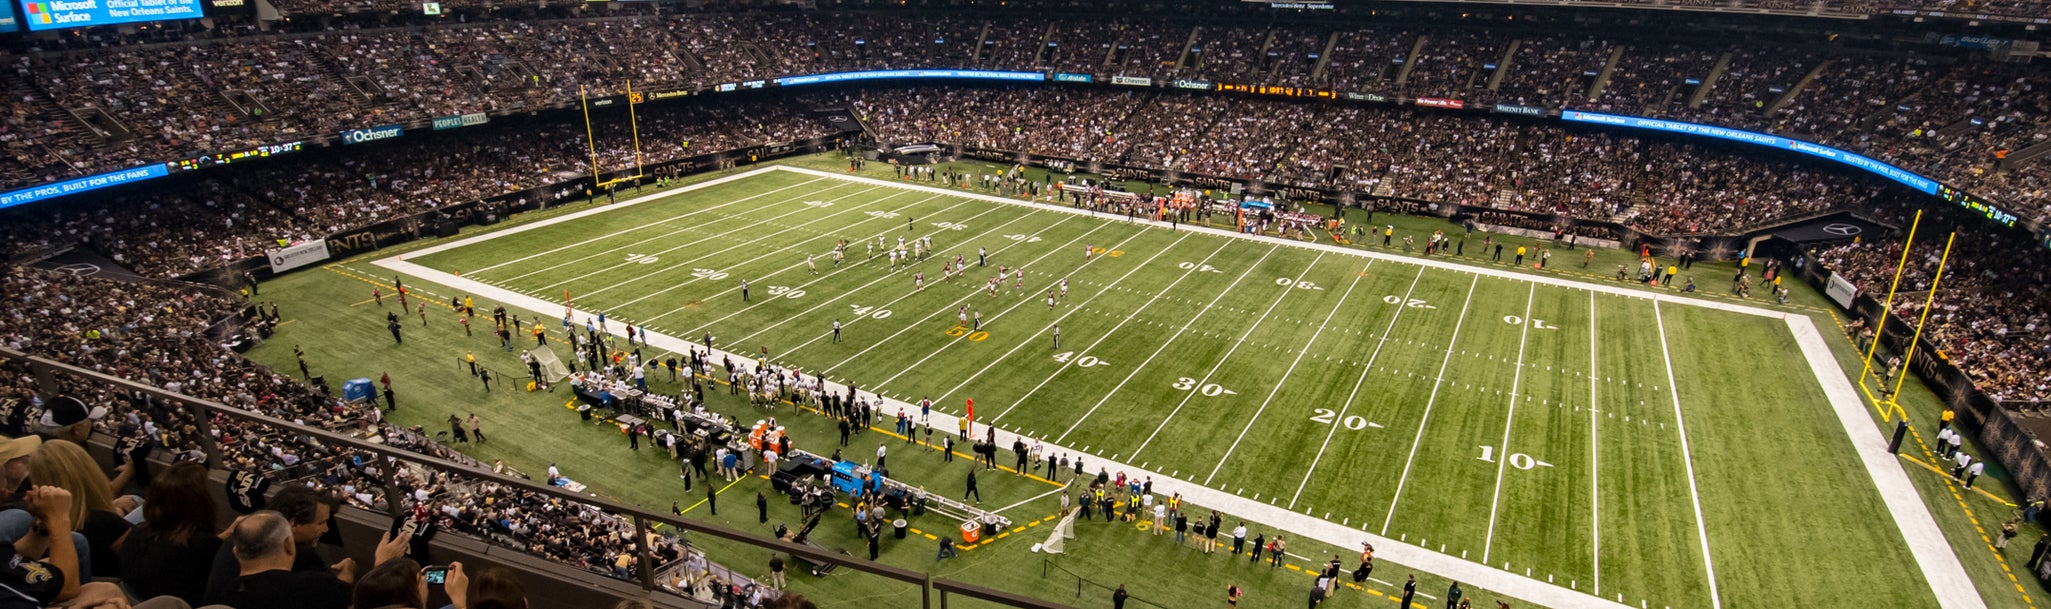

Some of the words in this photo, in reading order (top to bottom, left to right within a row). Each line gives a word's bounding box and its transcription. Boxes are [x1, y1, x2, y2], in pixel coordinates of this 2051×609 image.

[50, 0, 97, 11] Microsoft
[106, 0, 138, 9] Official
[109, 8, 129, 18] New
[130, 6, 164, 15] Orleans
[166, 5, 194, 14] Saints.
[54, 12, 91, 23] Surface
[1179, 79, 1208, 89] Ochsner
[631, 93, 642, 102] 25
[1497, 104, 1522, 113] WHITNEY
[1522, 106, 1540, 115] BANK
[434, 117, 462, 128] PEOPLES
[463, 113, 486, 125] HEALTH
[352, 128, 399, 142] Ochsner
[1637, 120, 1664, 129] OFFICIAL
[1665, 123, 1687, 131] TABLET
[1711, 128, 1725, 136] NEW
[1726, 130, 1754, 141] ORLEANS
[1755, 134, 1776, 144] SAINTS
[270, 143, 293, 154] 10:37
[976, 150, 1004, 161] SAINTS
[1842, 154, 1863, 166] TRUSTED
[655, 161, 694, 176] SAINTS
[1116, 167, 1148, 179] SAINTS
[1, 195, 12, 205] BY
[14, 190, 33, 200] THE
[36, 187, 62, 197] PROS,
[63, 180, 87, 192] BUILT
[89, 178, 108, 187] FOR
[109, 175, 126, 184] THE
[126, 169, 149, 180] FANS
[1195, 177, 1231, 190] SAINTS
[1283, 188, 1320, 200] SAINTS
[1376, 199, 1419, 213] SAINTS
[692, 267, 729, 281] 20
[1178, 261, 1213, 273] 40
[1275, 277, 1316, 291] 30
[767, 285, 806, 299] 30
[1383, 295, 1427, 309] 20
[852, 304, 892, 319] 40
[1503, 315, 1545, 329] 10
[945, 326, 989, 342] 50
[1052, 351, 1099, 368] 40
[1171, 376, 1224, 397] 30
[1309, 408, 1368, 431] 20
[1476, 445, 1536, 471] 10
